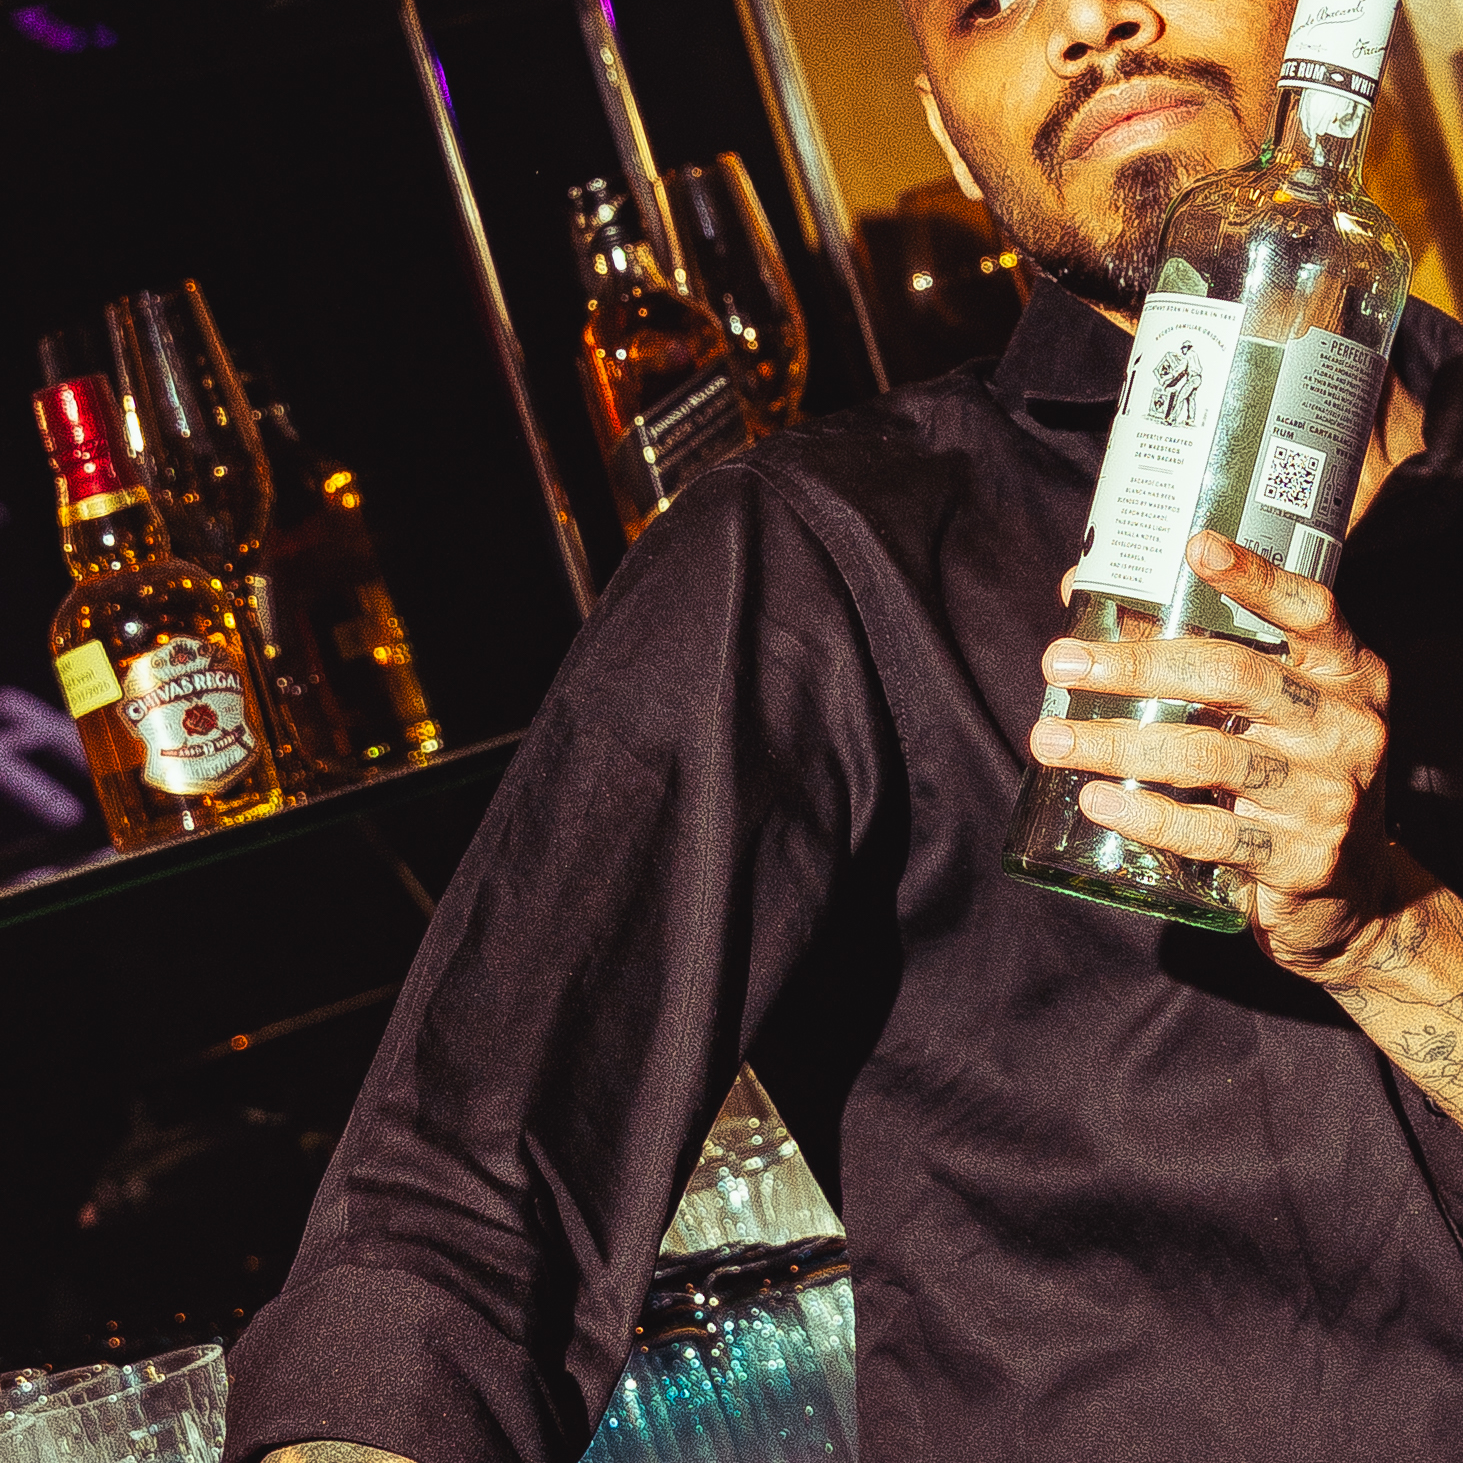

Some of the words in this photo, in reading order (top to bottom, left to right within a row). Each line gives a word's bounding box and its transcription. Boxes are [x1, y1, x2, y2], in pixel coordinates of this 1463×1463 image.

[1298, 62, 1327, 81] RUM
[1191, 308, 1208, 317] CUBA
[1330, 340, 1370, 368] PERFECT
[1276, 415, 1306, 431] BACARDÍ
[1273, 426, 1295, 440] RUM
[1164, 436, 1193, 447] CRAFTED
[126, 674, 193, 721] CHIVAS
